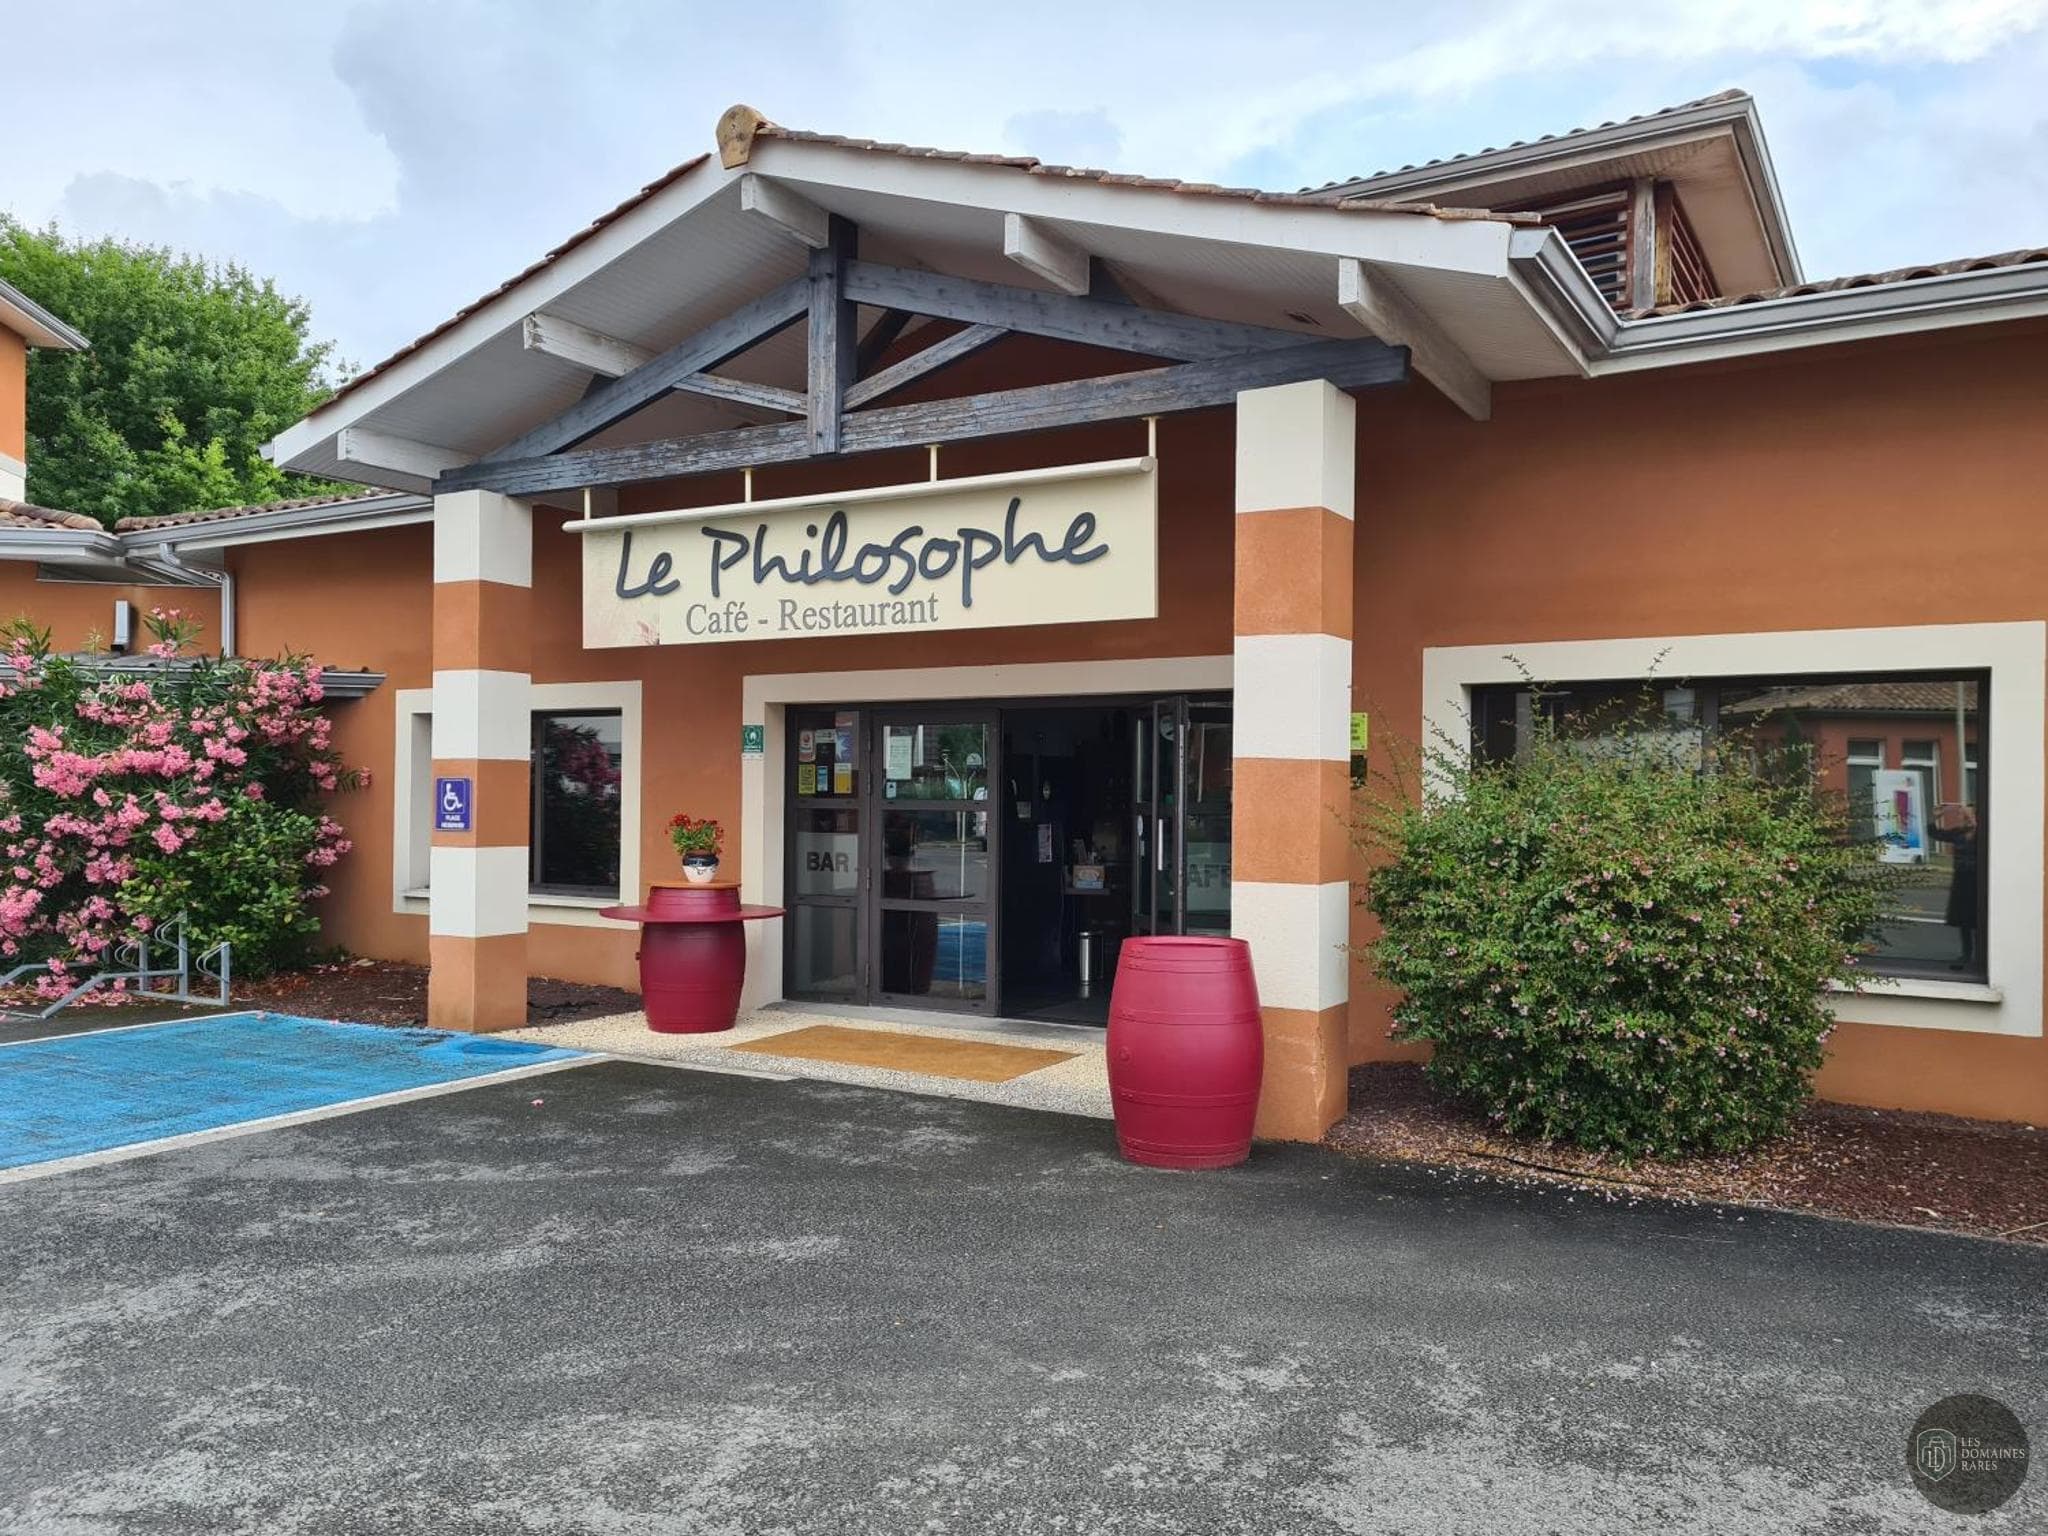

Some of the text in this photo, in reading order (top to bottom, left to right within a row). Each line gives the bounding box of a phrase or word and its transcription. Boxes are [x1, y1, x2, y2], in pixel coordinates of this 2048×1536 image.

[616, 498, 1109, 608] Le Philosophe
[686, 604, 749, 635] Café
[778, 593, 939, 631] Restaurant
[807, 852, 849, 872] BAR
